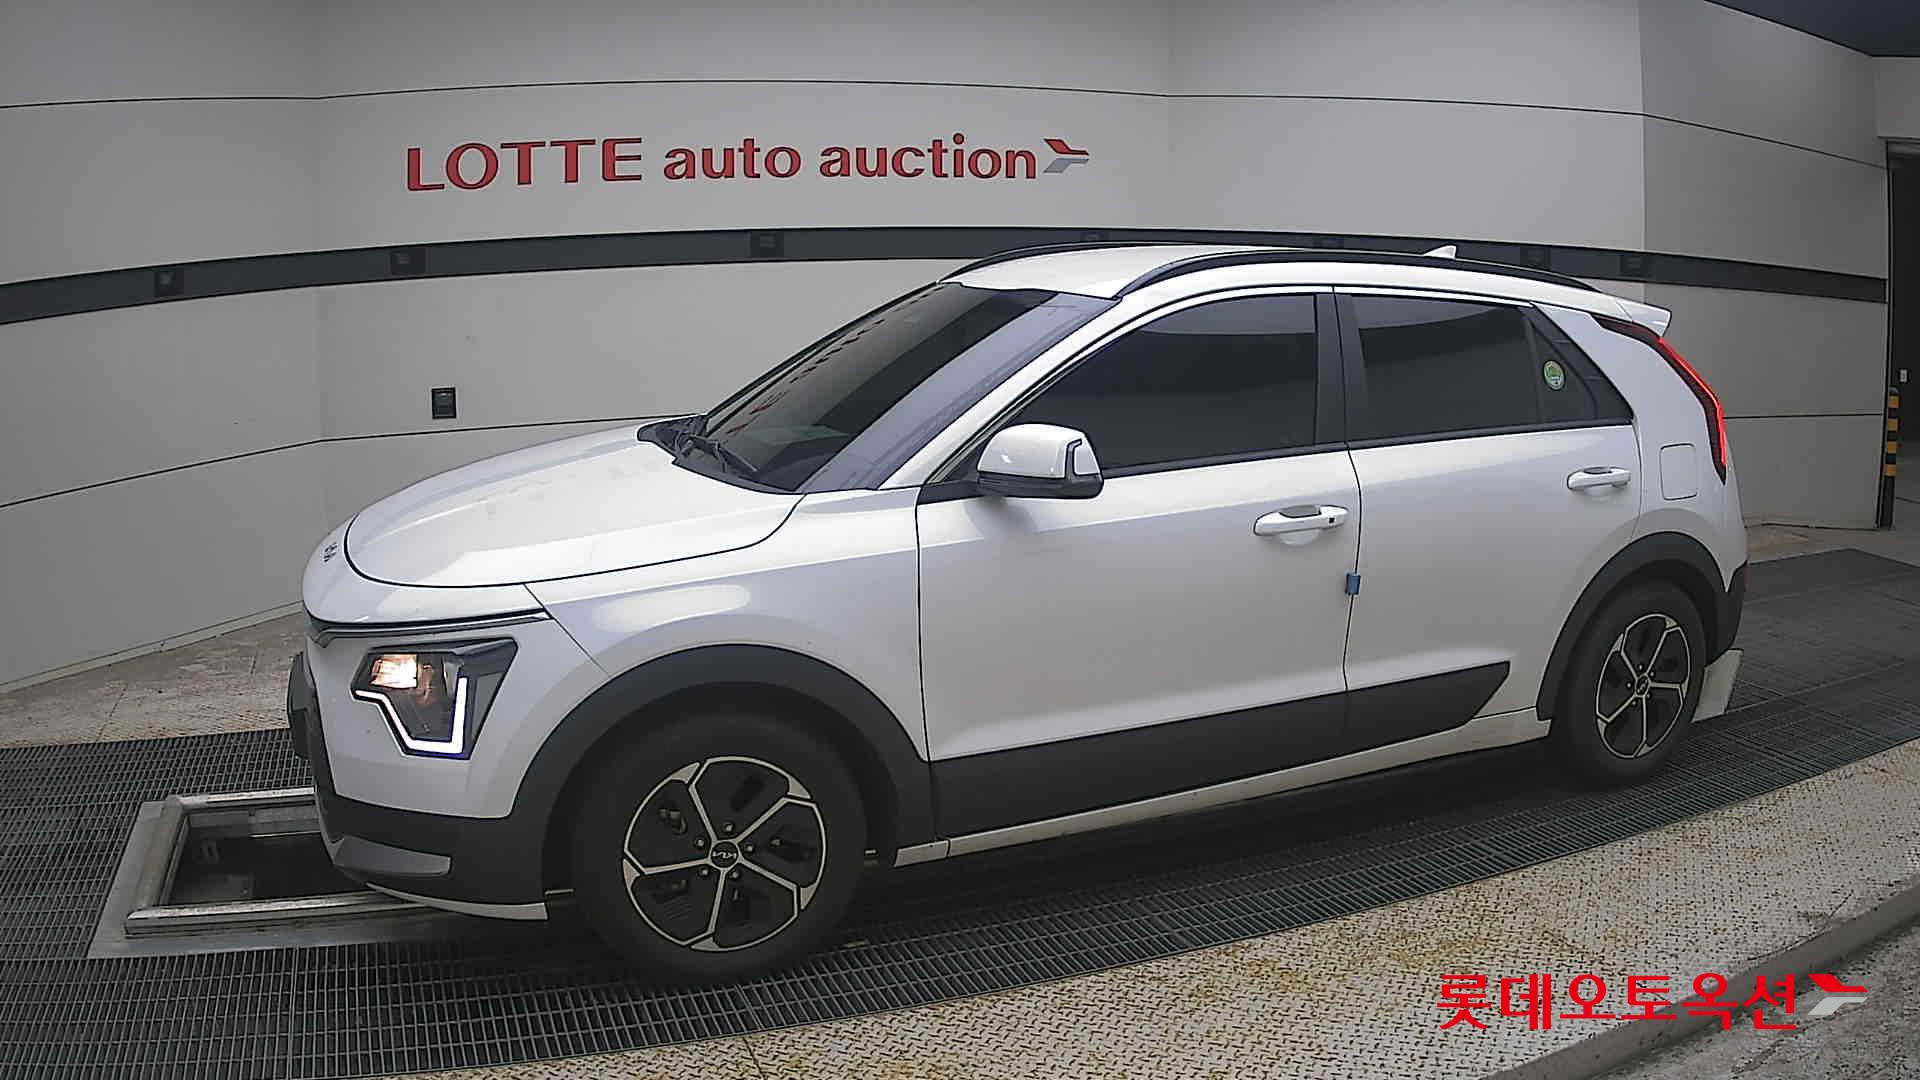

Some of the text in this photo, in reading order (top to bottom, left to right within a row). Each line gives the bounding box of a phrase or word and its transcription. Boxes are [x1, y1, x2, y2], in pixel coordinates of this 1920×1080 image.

[407, 133, 1037, 192] LOTTE auto auction
